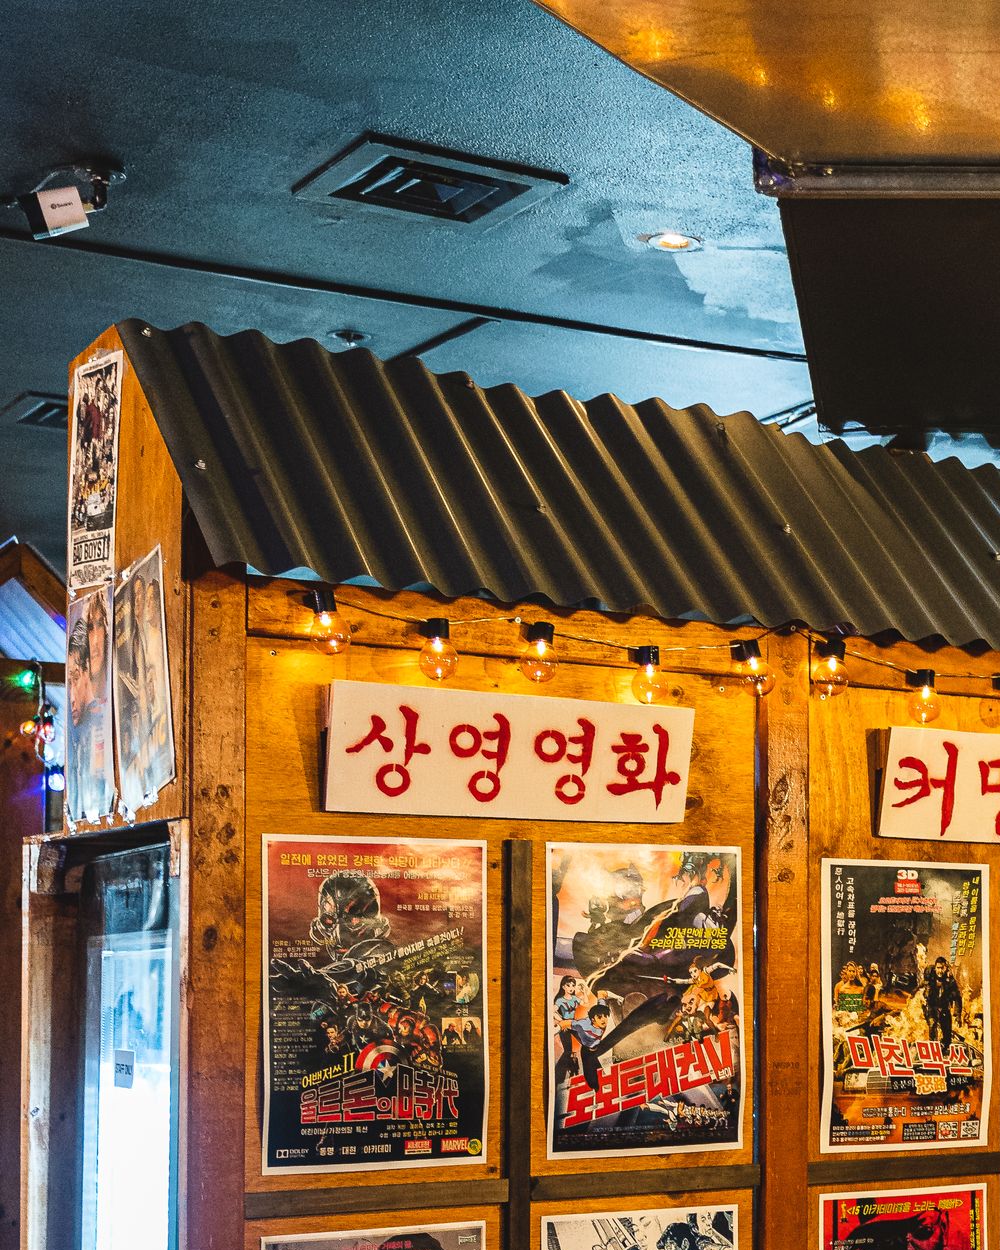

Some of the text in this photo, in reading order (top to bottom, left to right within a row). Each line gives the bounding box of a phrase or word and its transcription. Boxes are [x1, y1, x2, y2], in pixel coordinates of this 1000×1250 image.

[84, 540, 102, 560] BOYS
[316, 854, 348, 867] 없었던
[896, 869, 919, 880] 3D
[649, 938, 674, 950] 우리의
[686, 938, 711, 949] 우리의
[711, 938, 728, 950] 영웅
[364, 1144, 392, 1154] 아카데미
[442, 1138, 469, 1152] MARVEL
